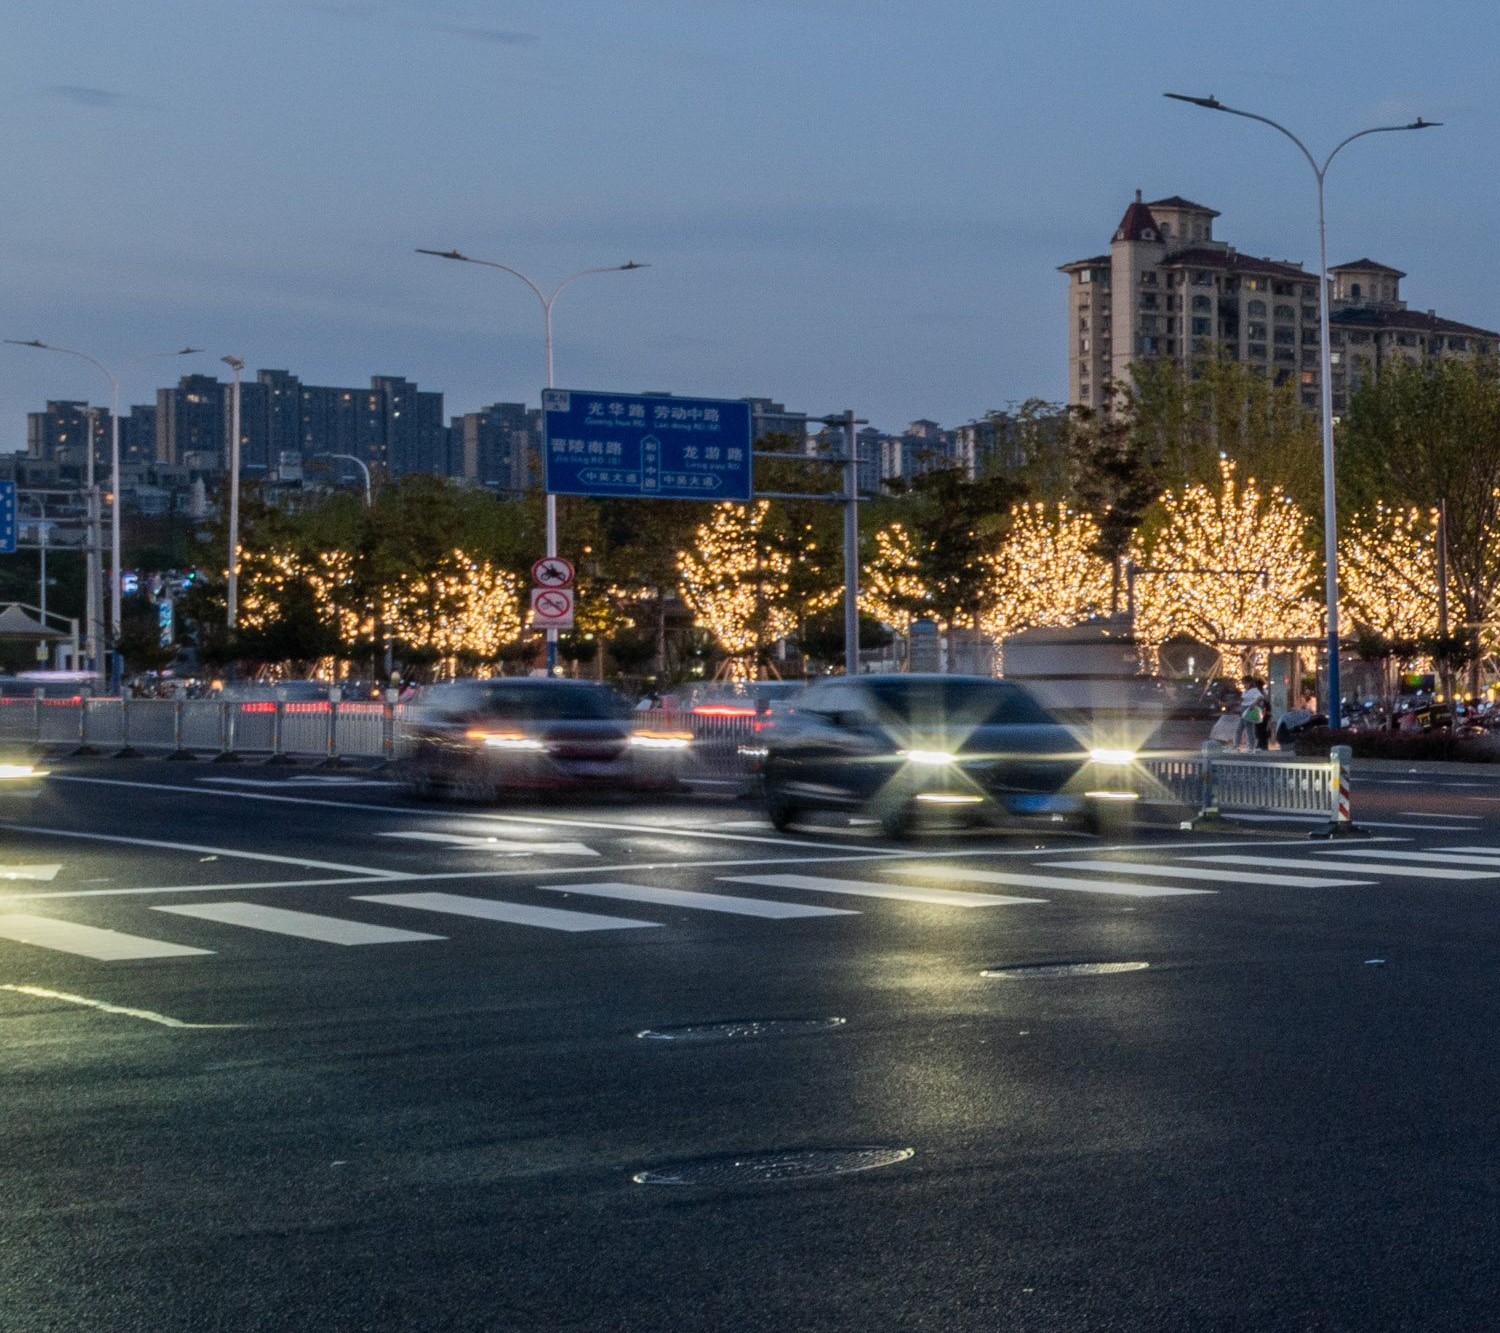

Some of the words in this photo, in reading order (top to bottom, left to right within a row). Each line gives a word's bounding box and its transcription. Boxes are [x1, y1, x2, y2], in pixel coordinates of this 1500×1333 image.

[588, 402, 645, 418] 光华路
[654, 405, 720, 422] 劳动中路
